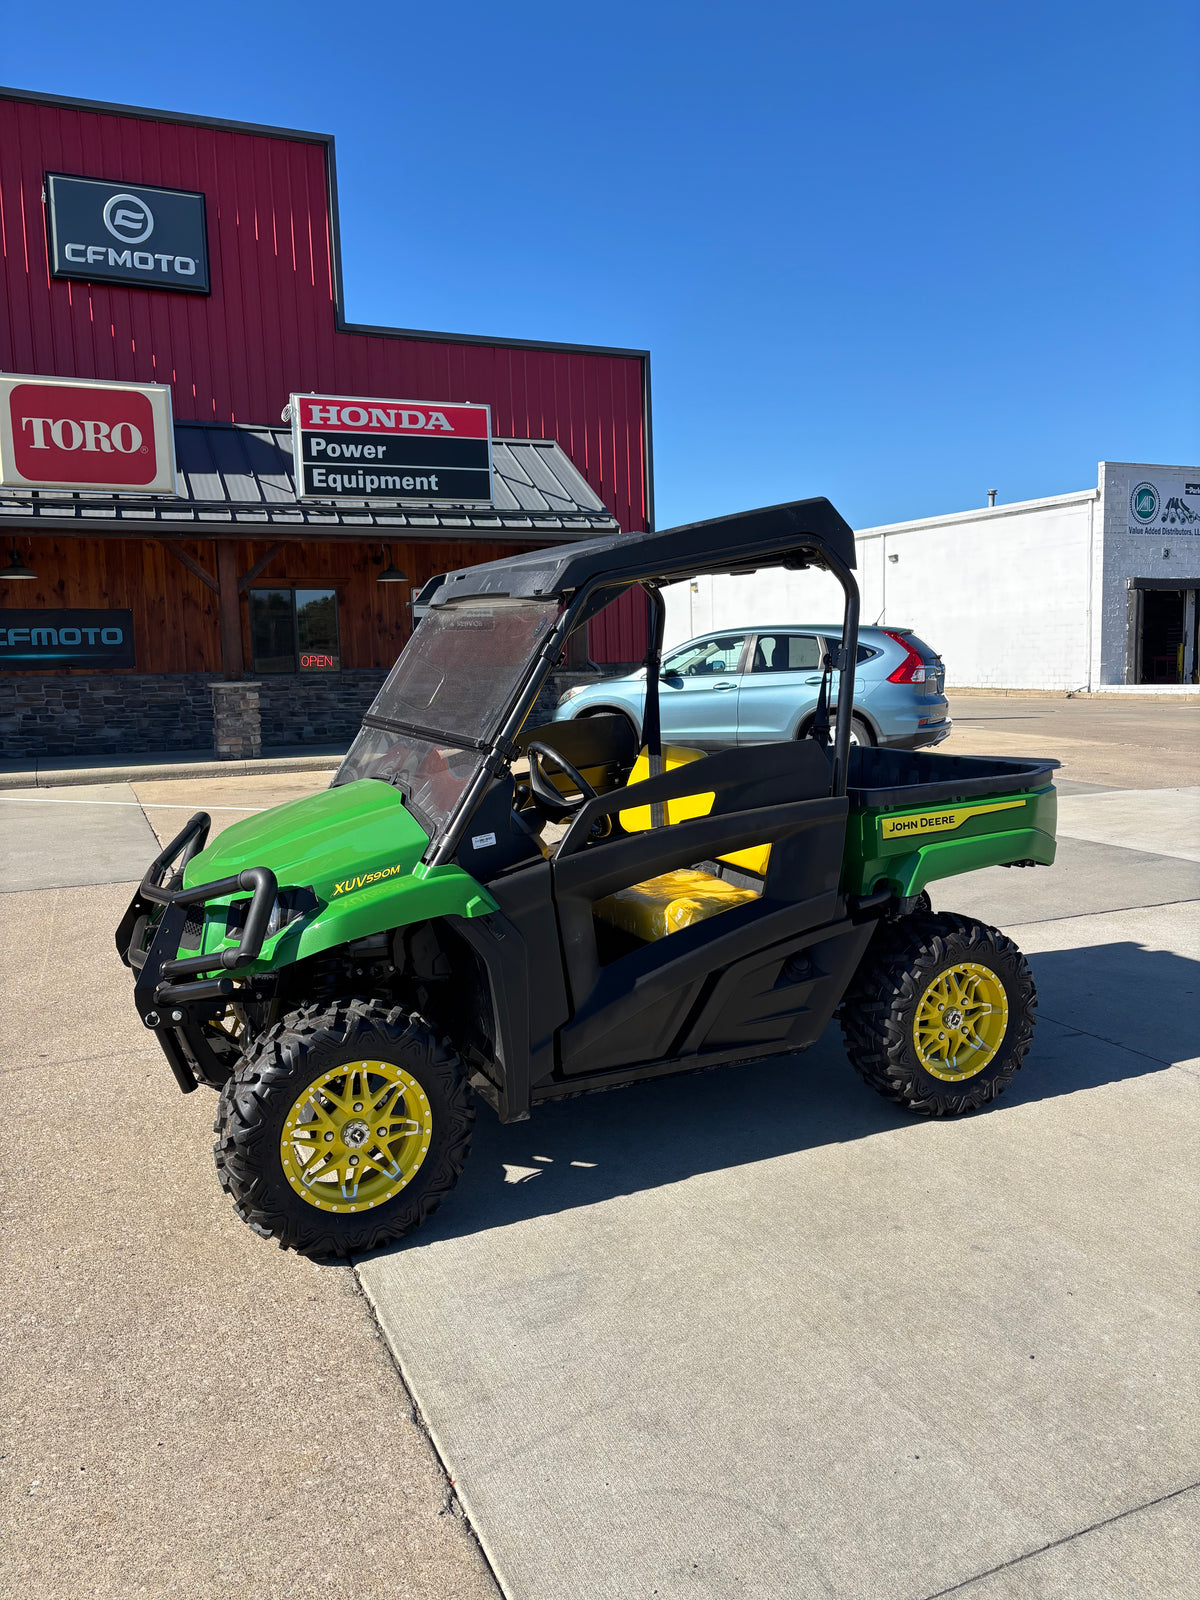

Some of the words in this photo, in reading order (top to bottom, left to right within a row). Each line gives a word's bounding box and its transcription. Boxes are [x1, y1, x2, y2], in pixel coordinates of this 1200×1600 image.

[65, 243, 196, 275] CFMOTO
[308, 404, 455, 431] HONDA
[21, 417, 143, 454] TORO
[310, 437, 387, 459] Power
[312, 468, 439, 493] Equipment
[1128, 526, 1144, 535] Value
[1144, 527, 1161, 535] Added
[1162, 527, 1194, 536] Distributors,
[0, 627, 123, 646] FMOTO
[300, 655, 333, 667] OPEN
[889, 820, 918, 832] JOHN
[920, 815, 956, 828] DEERE
[331, 863, 402, 897] XUV590M
